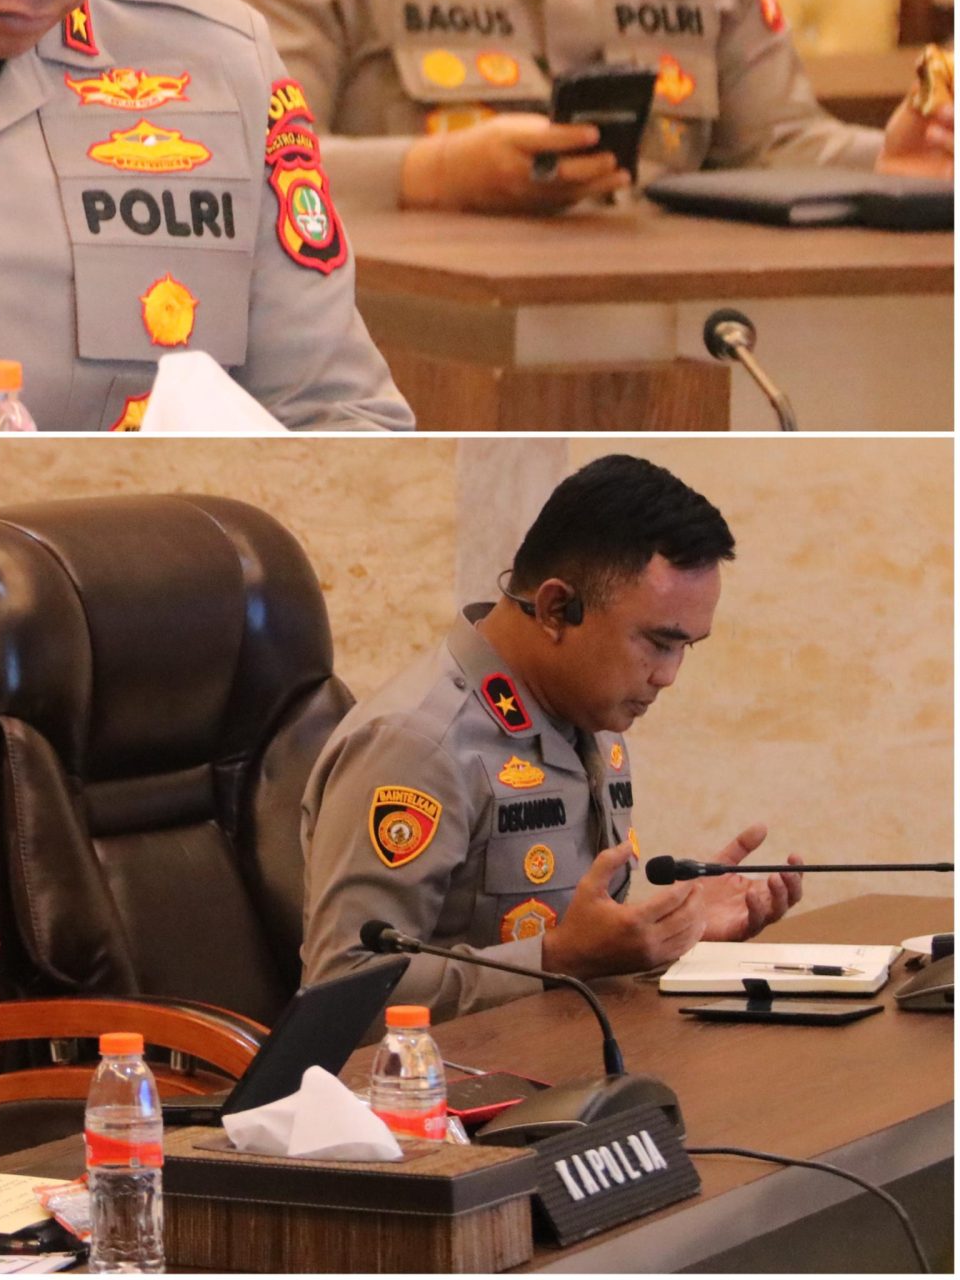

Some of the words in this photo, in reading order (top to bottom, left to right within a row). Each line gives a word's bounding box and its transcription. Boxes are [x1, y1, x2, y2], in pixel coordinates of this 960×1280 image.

[403, 1, 514, 37] BAGUS
[615, 3, 705, 37] POLRI
[81, 189, 236, 239] POLRI
[554, 1129, 668, 1201] KAPOLDA
